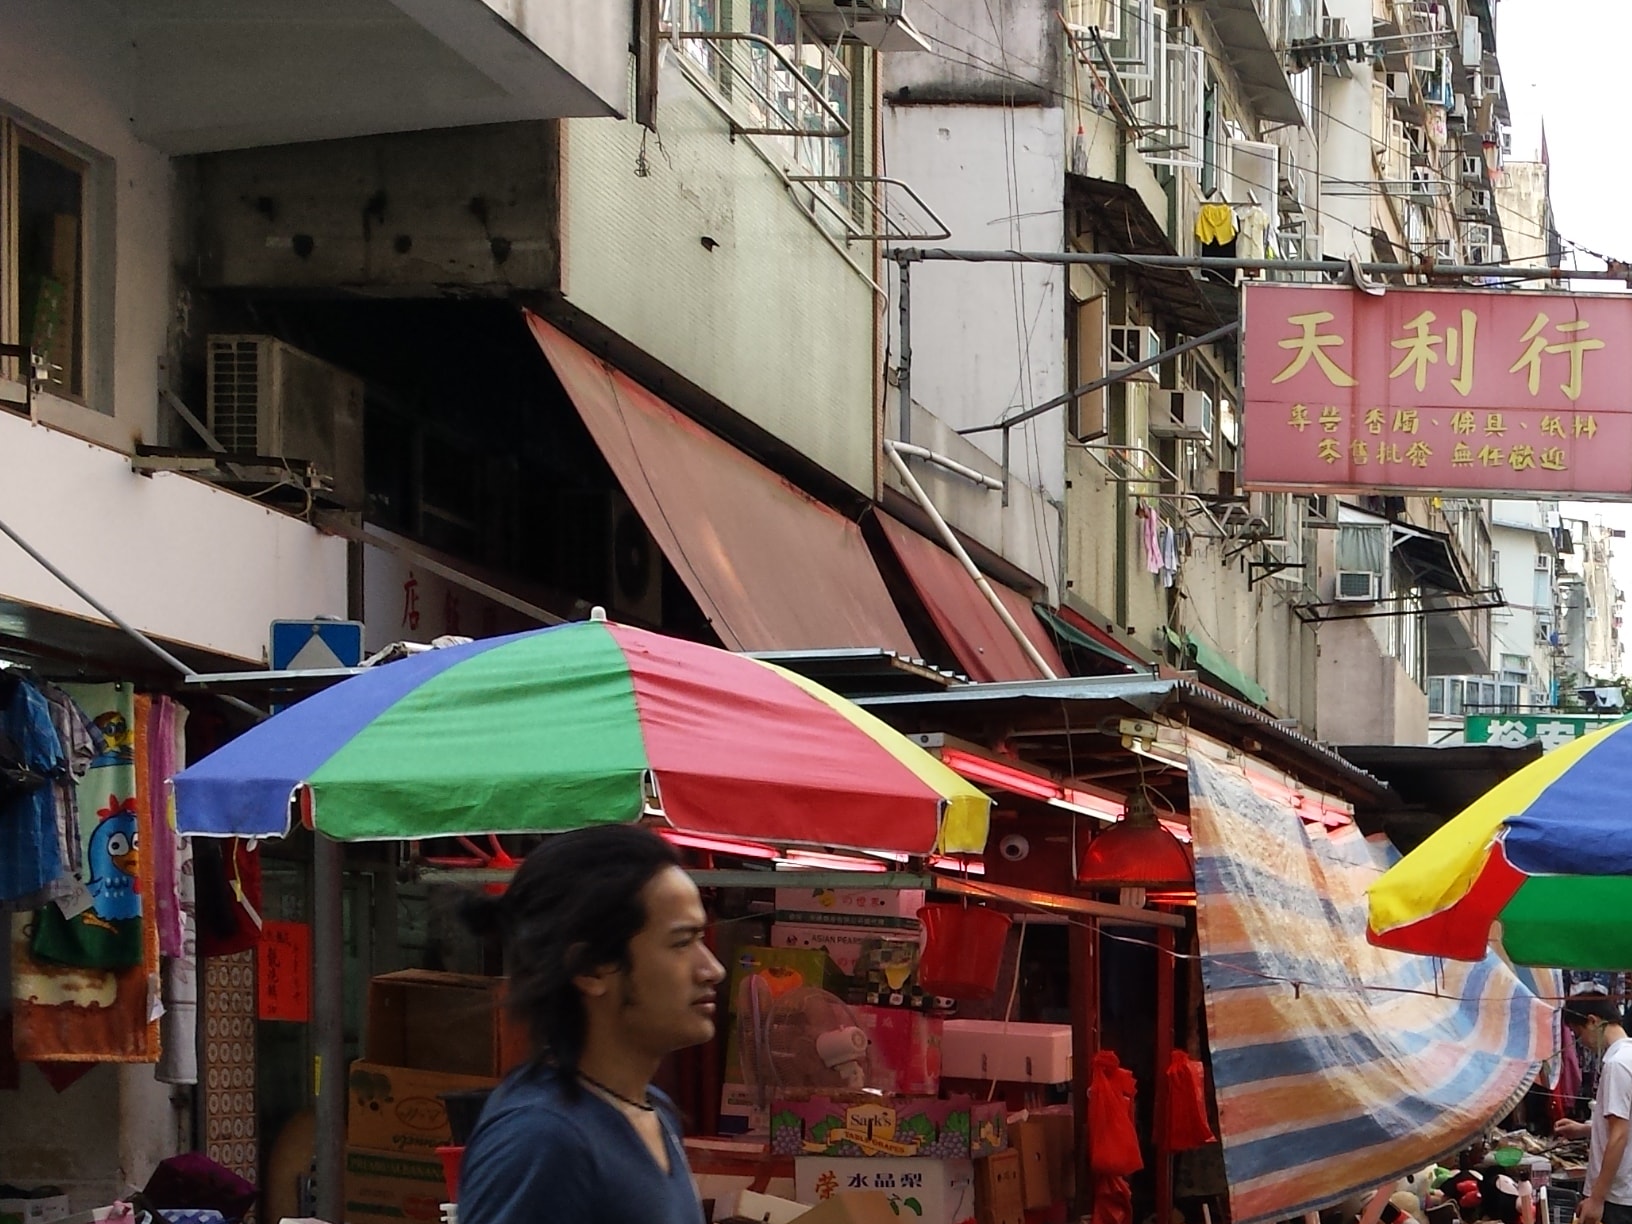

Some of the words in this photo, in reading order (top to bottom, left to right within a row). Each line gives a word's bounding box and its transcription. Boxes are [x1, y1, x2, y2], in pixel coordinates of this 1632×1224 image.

[1272, 309, 1605, 400] 天利行
[811, 934, 837, 944] ASIAN
[850, 1112, 892, 1127] Sark's
[847, 1172, 923, 1188] 水晶梨
